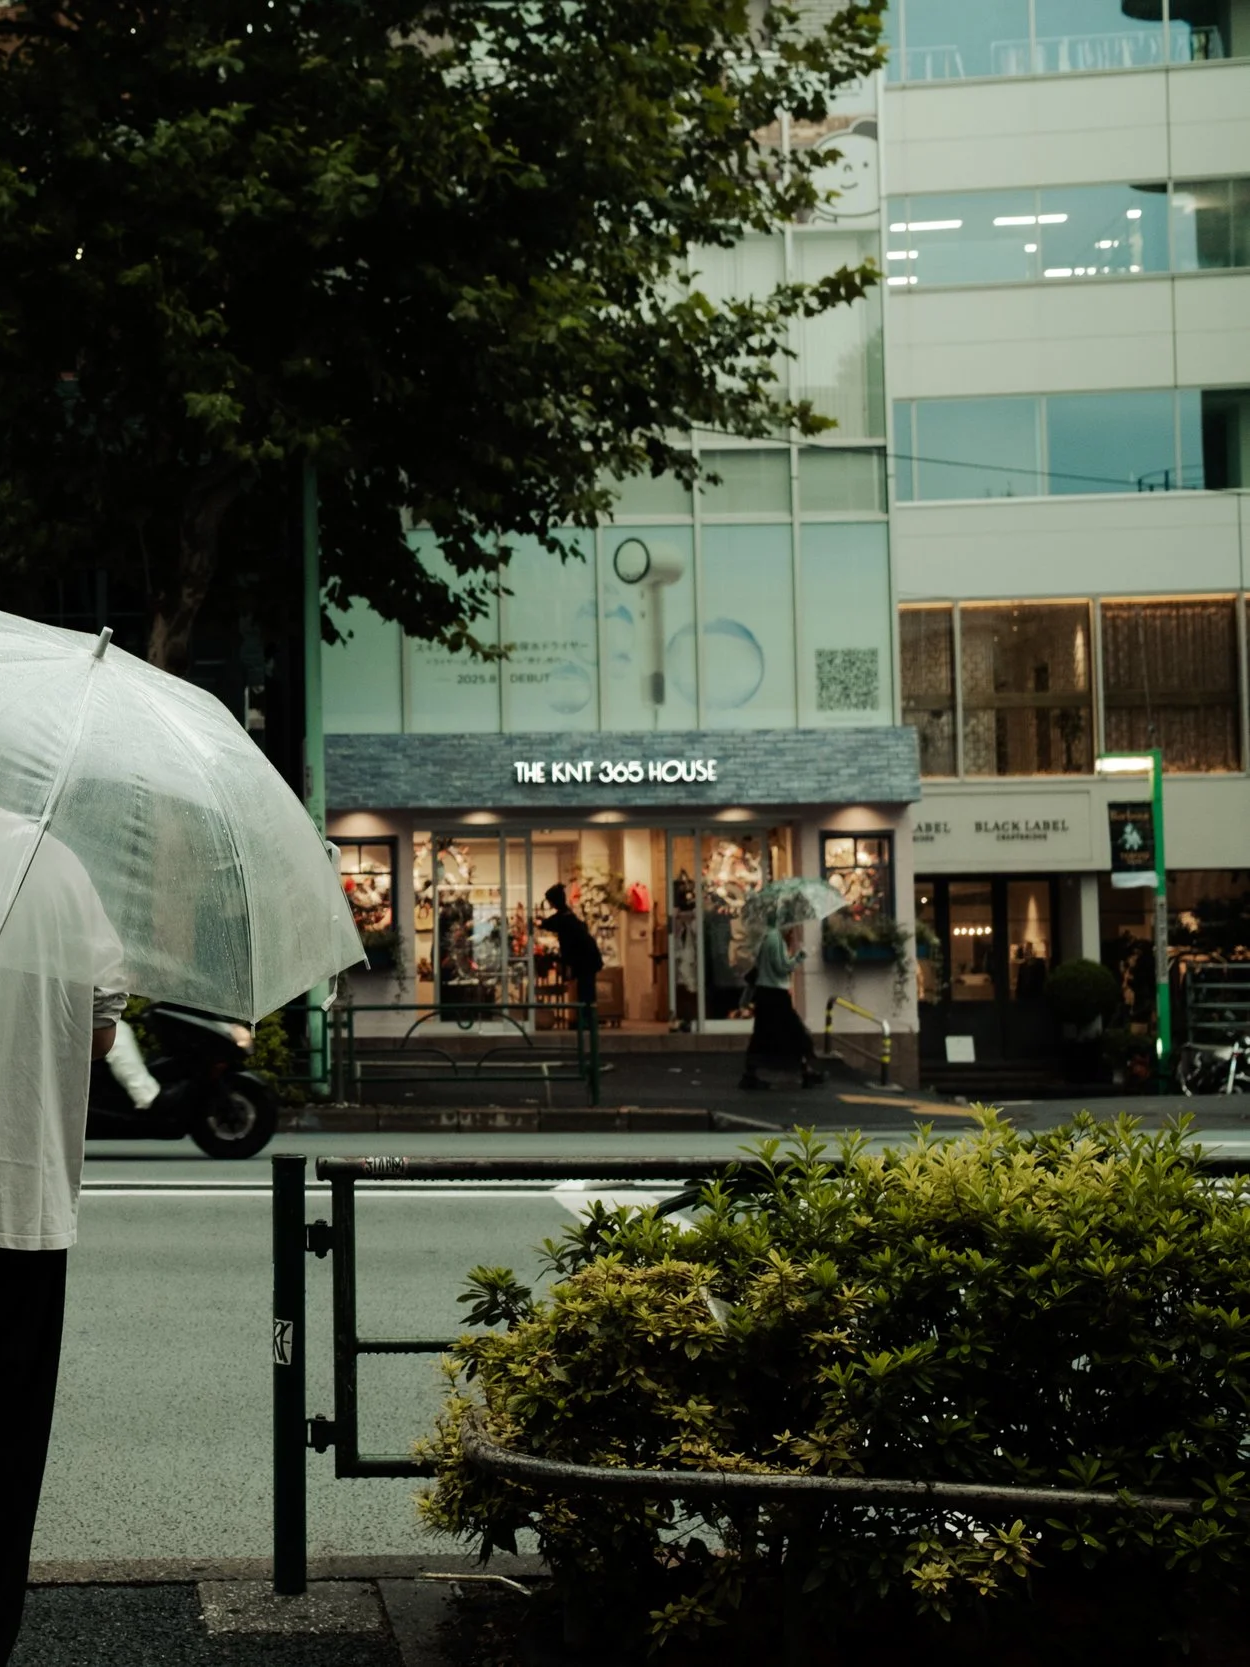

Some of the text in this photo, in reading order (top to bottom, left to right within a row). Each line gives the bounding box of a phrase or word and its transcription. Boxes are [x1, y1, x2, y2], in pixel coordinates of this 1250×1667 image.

[509, 672, 551, 684] DEBUT
[513, 759, 718, 783] THE KNT 365 HOUSE
[912, 820, 951, 834] ABEL
[974, 818, 1069, 833] BLACK LABEL
